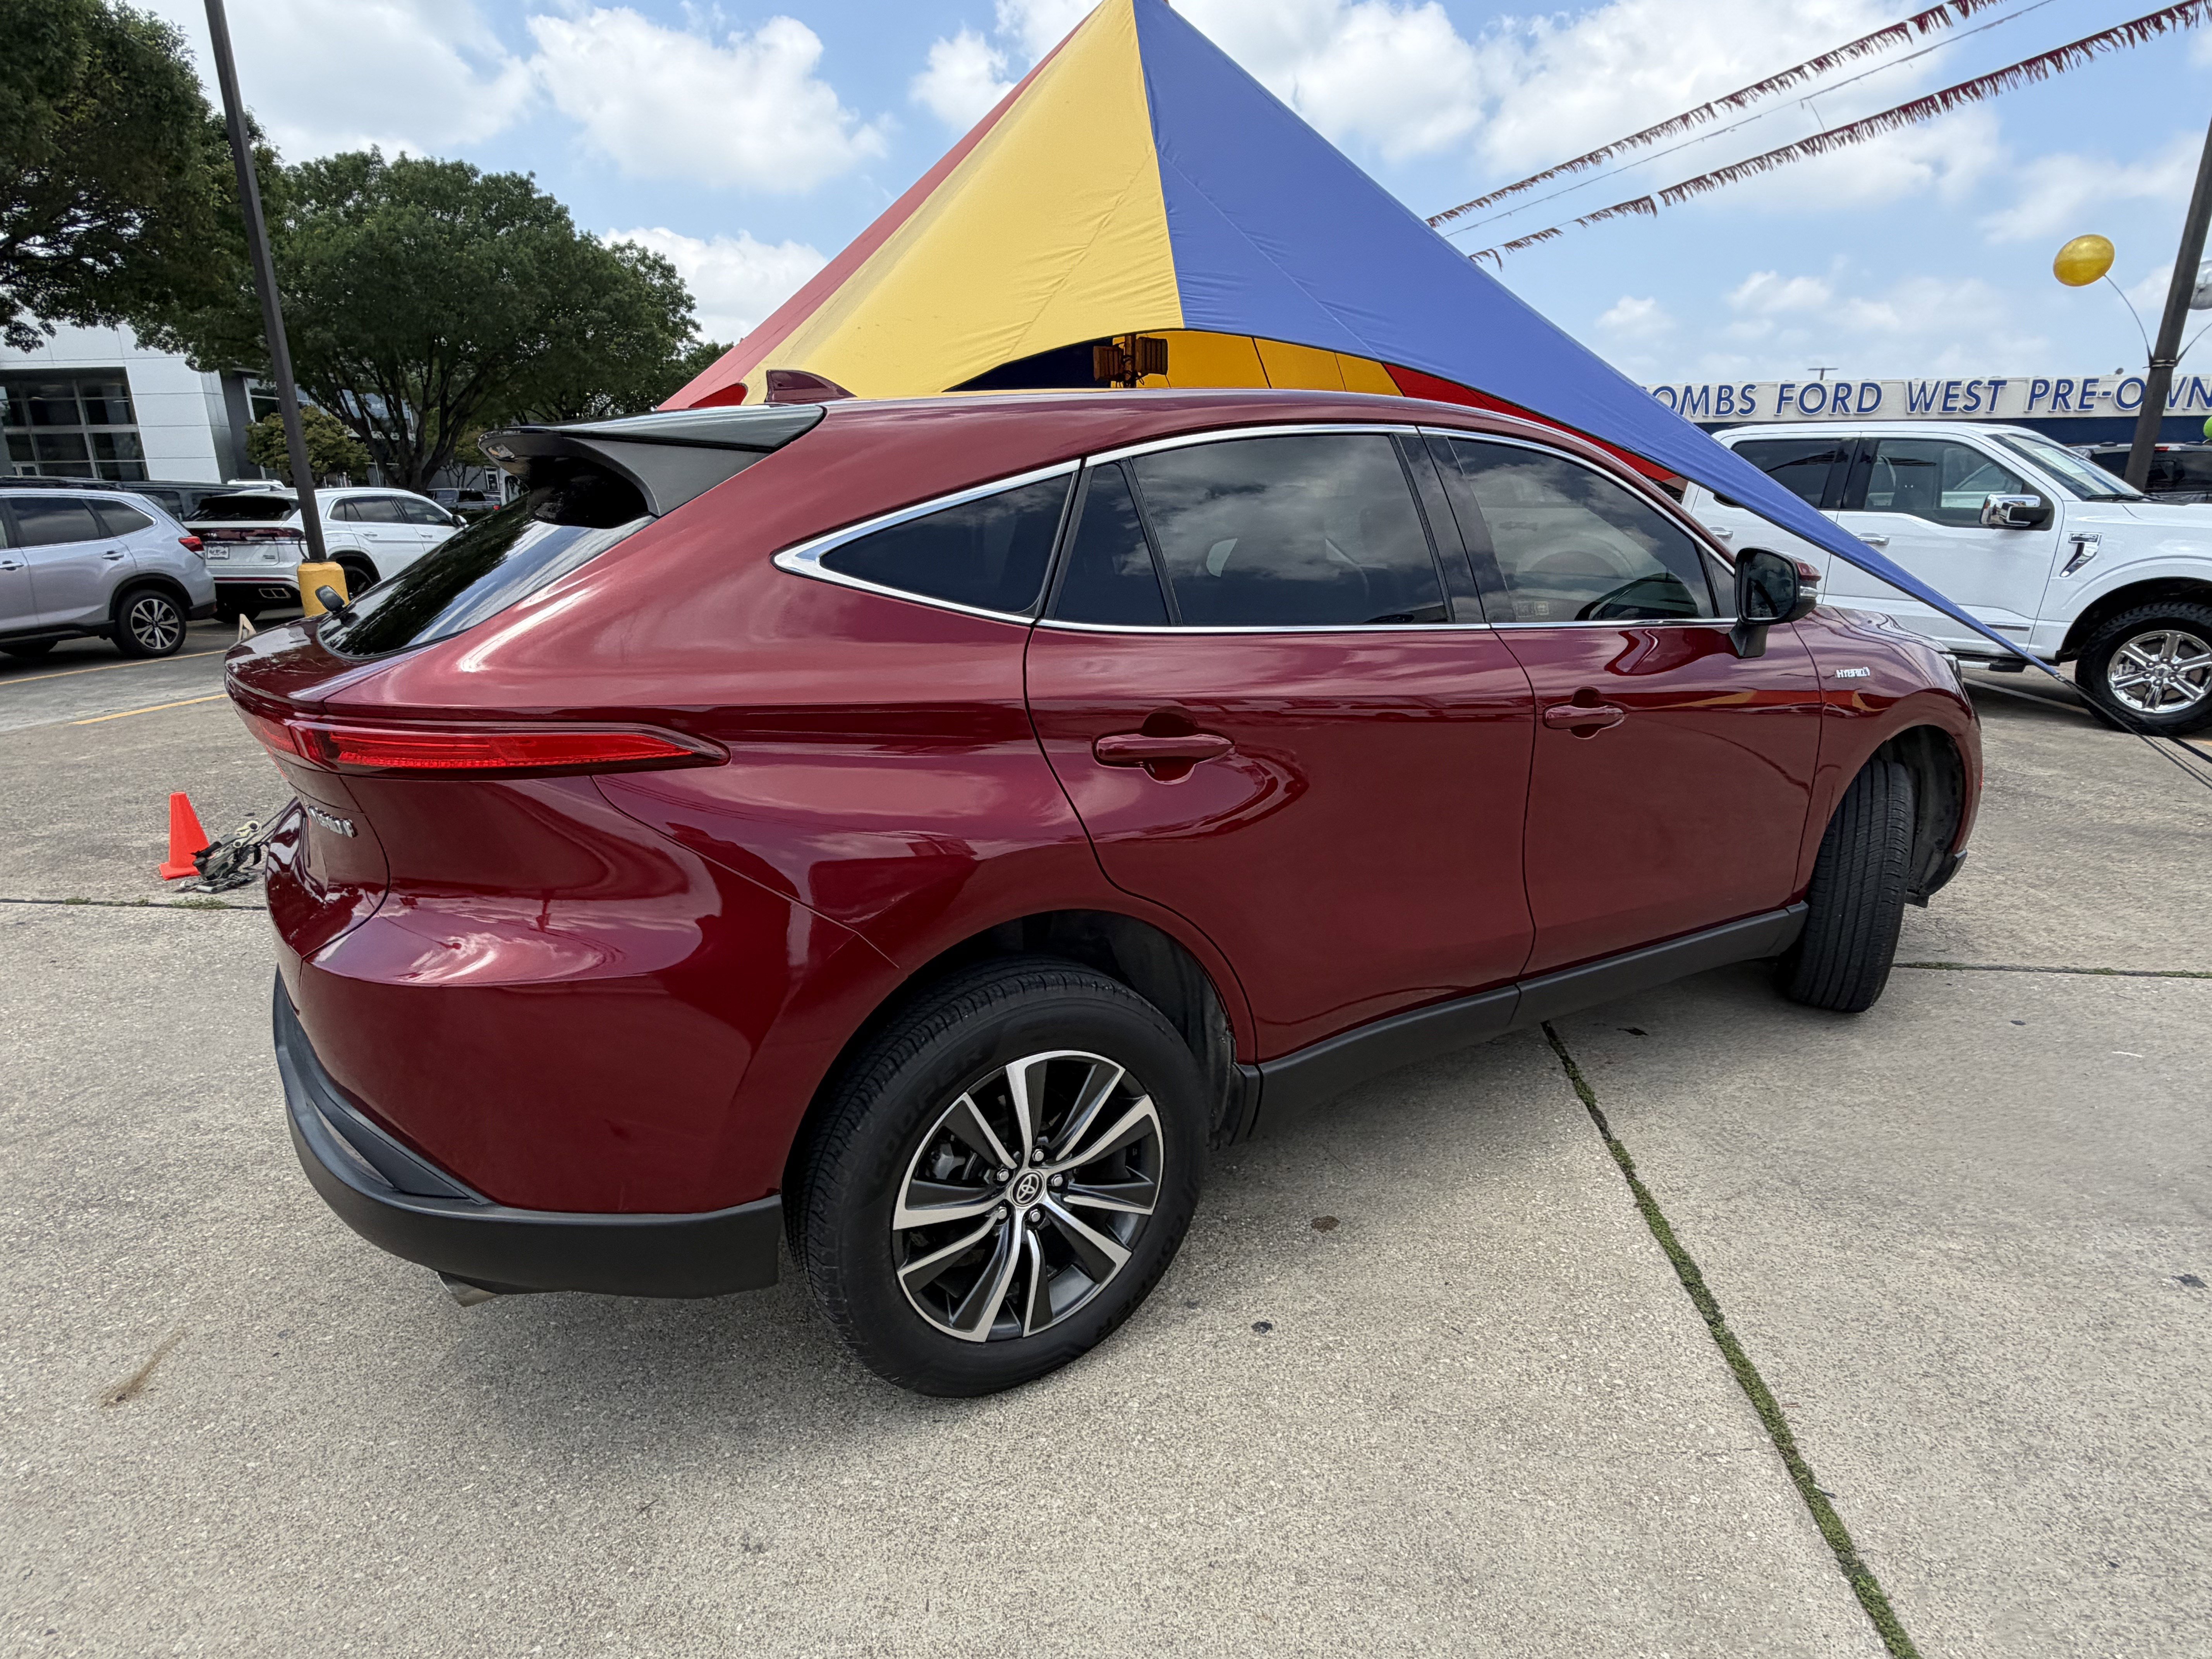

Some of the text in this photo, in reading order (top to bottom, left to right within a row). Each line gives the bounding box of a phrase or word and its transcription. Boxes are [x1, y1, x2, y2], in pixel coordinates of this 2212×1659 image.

[1641, 384, 1757, 416] OMBS
[1776, 383, 1882, 414] FORD
[1908, 380, 2008, 412] WEST
